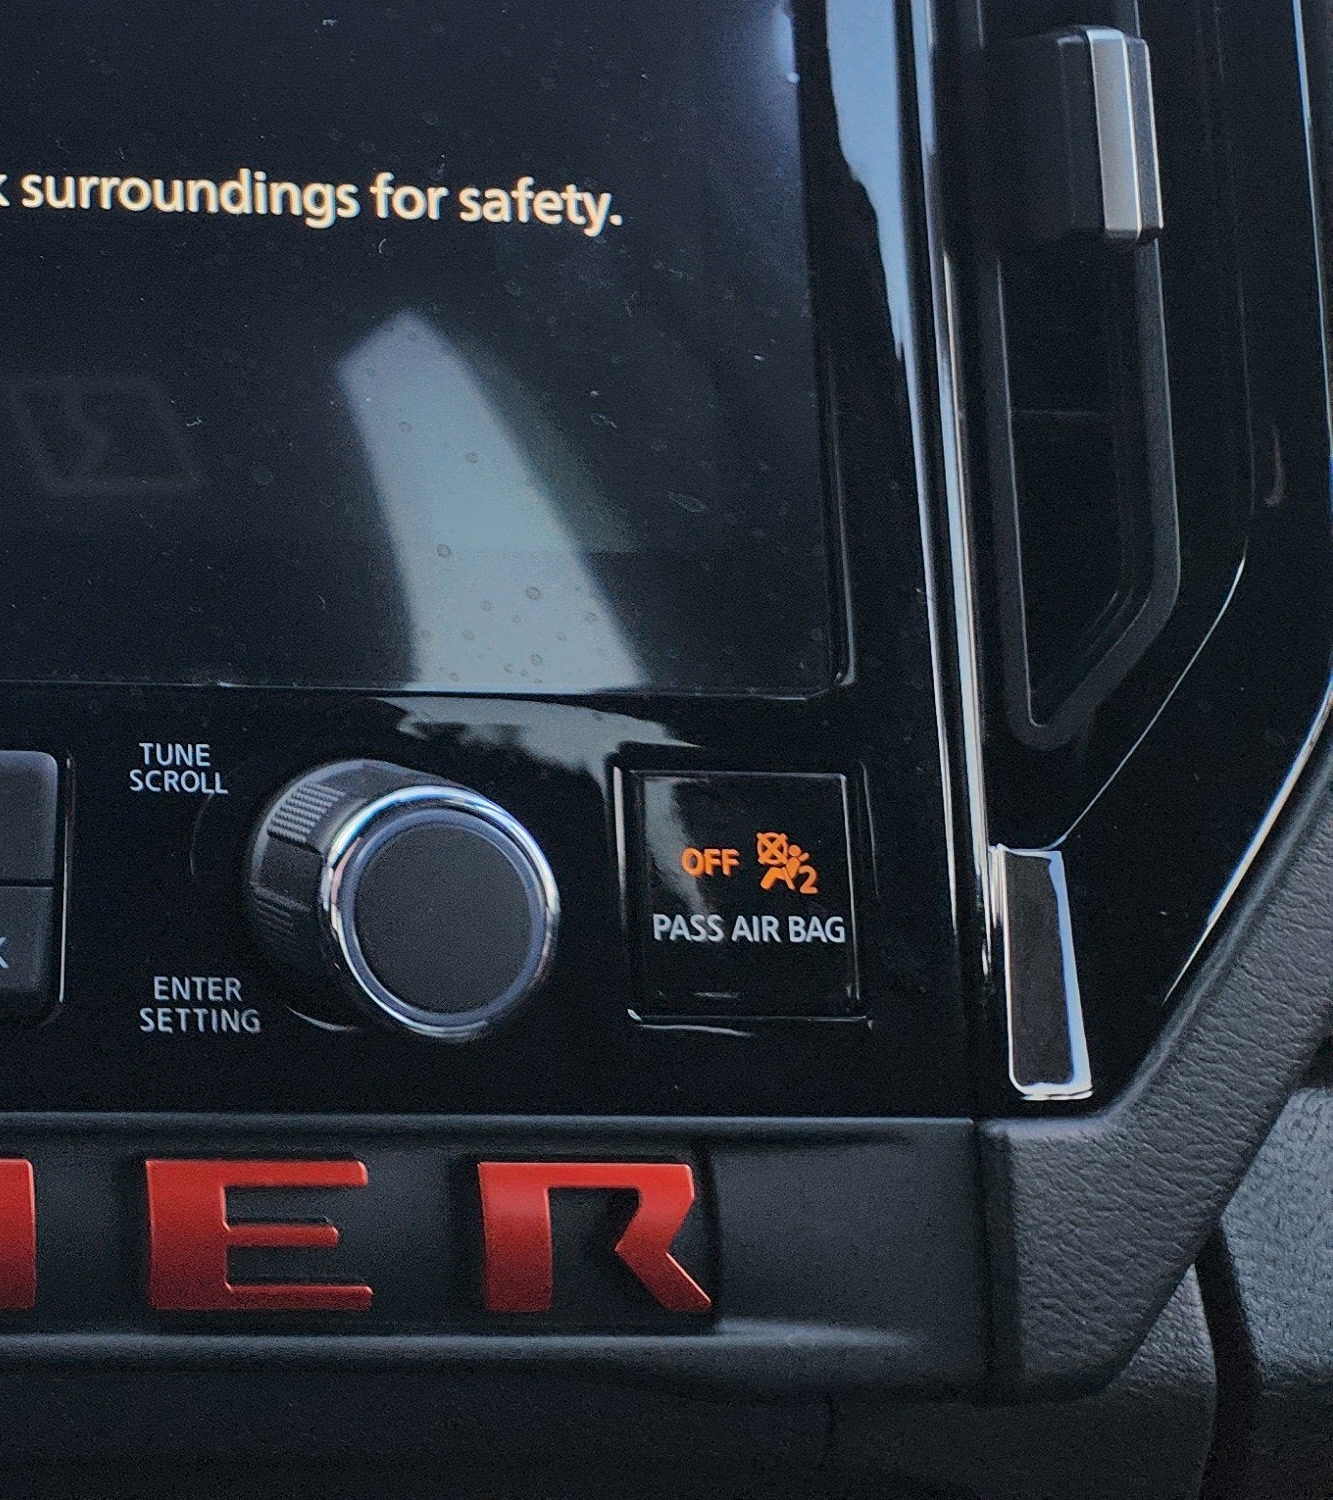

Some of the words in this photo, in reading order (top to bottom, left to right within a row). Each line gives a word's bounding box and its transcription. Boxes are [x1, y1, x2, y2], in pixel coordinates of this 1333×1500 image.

[20, 167, 361, 230] surroundings
[369, 172, 450, 221] for
[457, 176, 624, 237] safety.
[138, 741, 212, 768] TUNE
[129, 767, 229, 796] SCROLL
[680, 846, 740, 878] OFF
[652, 912, 726, 943] PASS
[730, 914, 782, 944] AIR
[787, 914, 847, 944] BAG
[152, 975, 243, 1003] ENTER
[138, 1006, 261, 1035] SETTING
